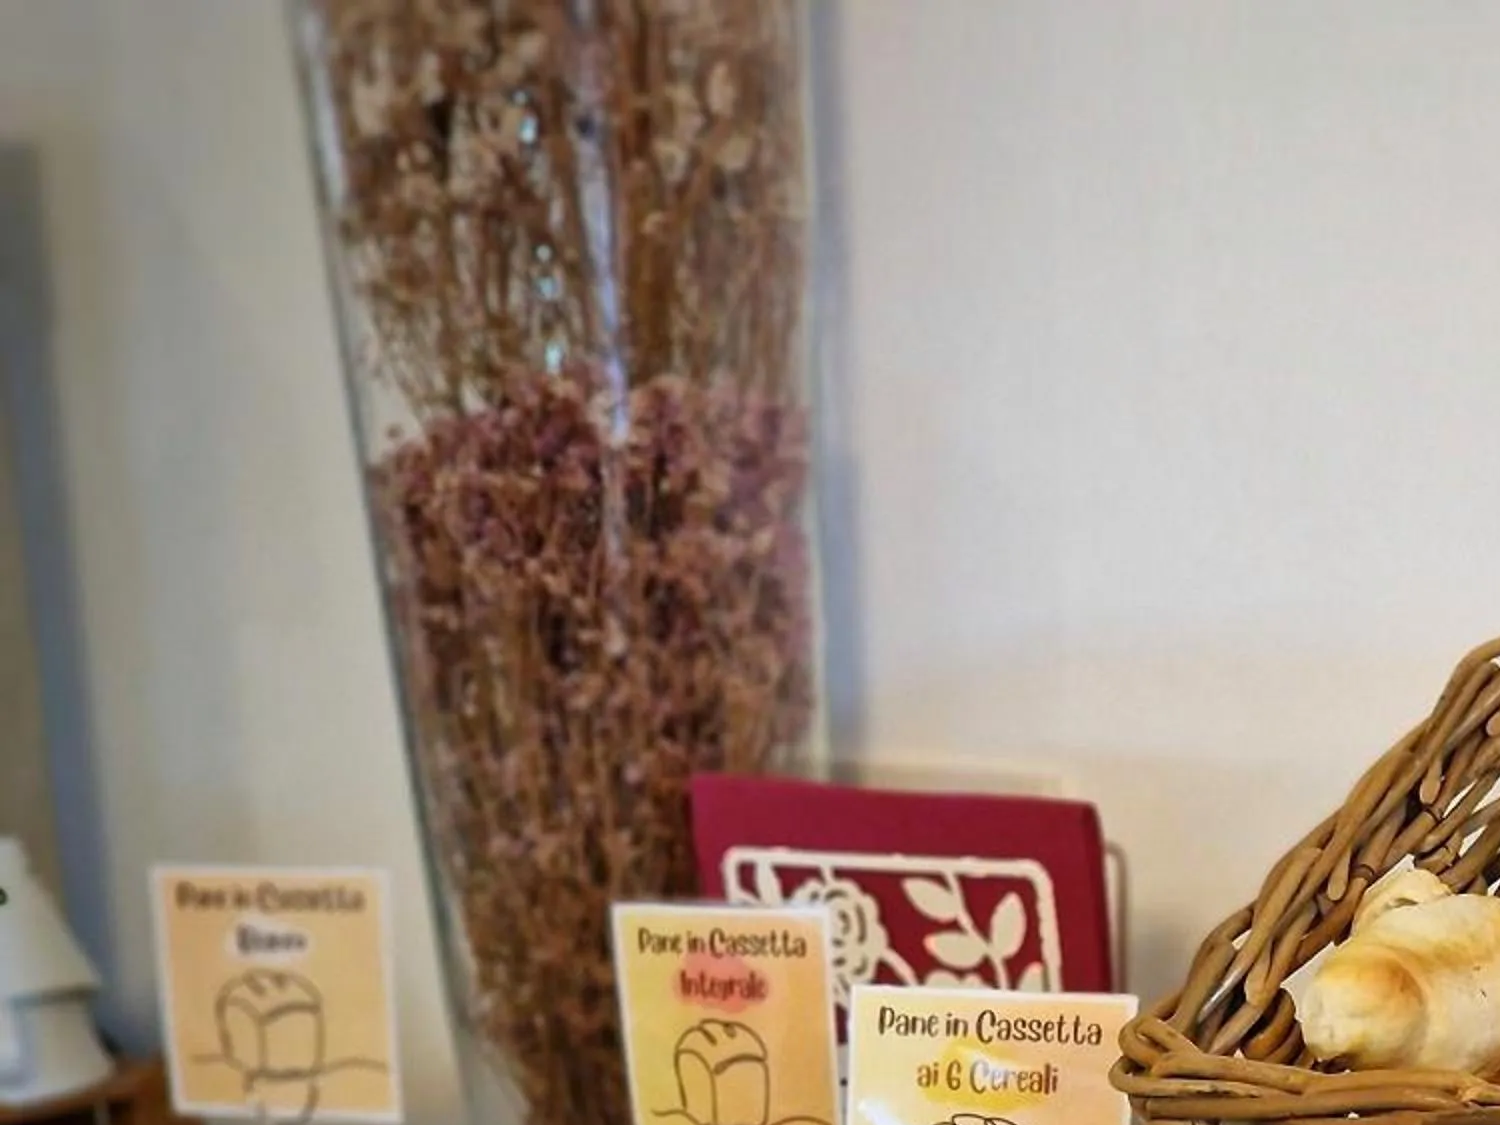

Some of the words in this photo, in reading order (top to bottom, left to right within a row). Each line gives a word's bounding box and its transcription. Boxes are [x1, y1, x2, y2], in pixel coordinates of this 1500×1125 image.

[638, 927, 684, 954] Pane
[686, 930, 706, 953] in
[709, 927, 808, 958] Cassetta
[680, 969, 767, 1000] Integrale
[878, 1006, 939, 1038] Pane
[945, 1012, 969, 1038] in
[975, 1009, 1102, 1046] Cassetta
[917, 1061, 940, 1087] ai
[946, 1059, 963, 1091] 6
[970, 1059, 1060, 1095] Cereali
